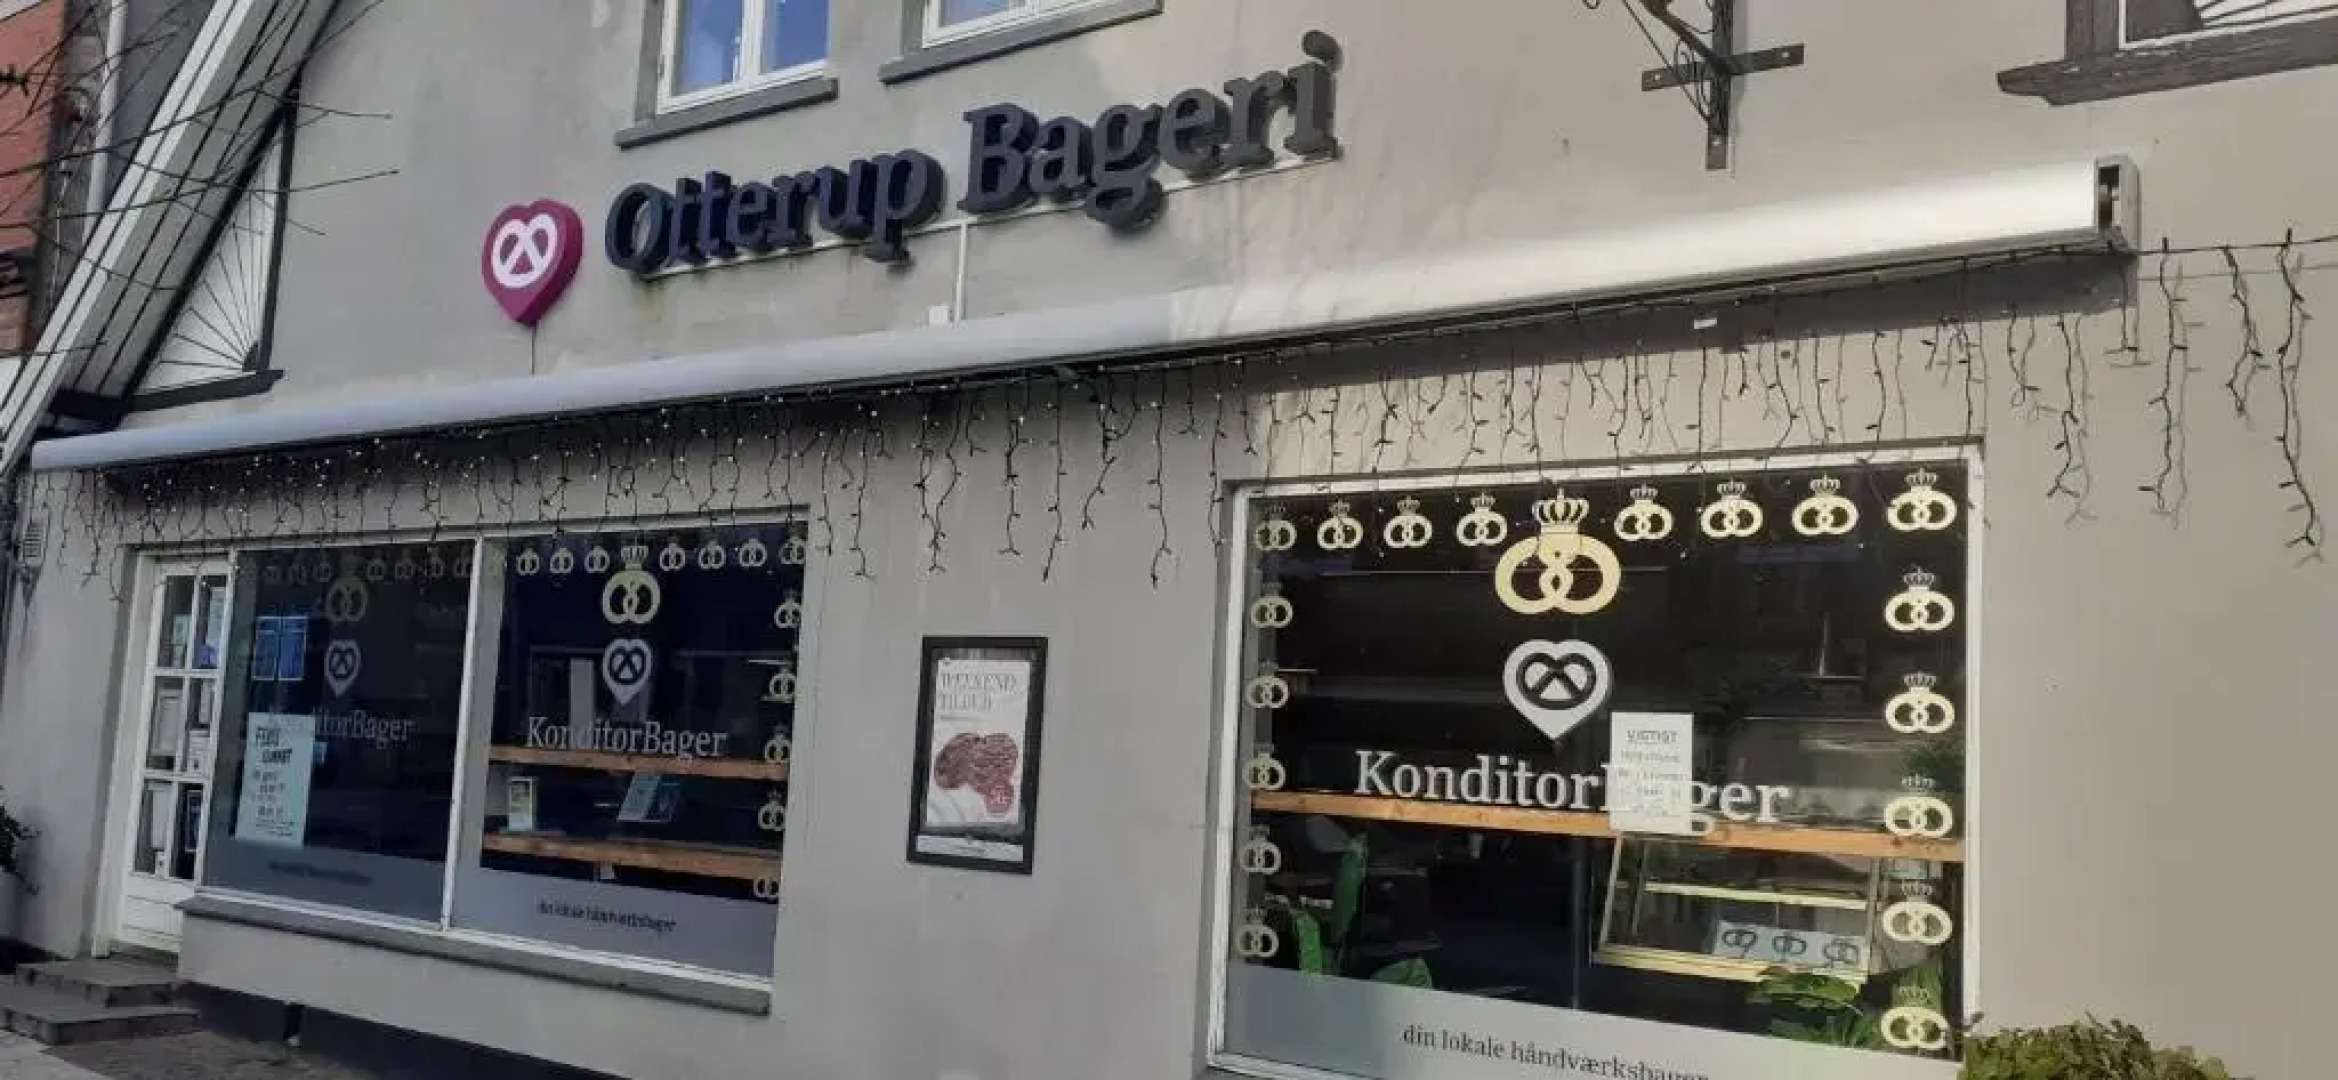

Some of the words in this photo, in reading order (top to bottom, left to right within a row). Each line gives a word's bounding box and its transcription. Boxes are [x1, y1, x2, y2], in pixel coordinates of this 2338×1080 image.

[604, 148, 946, 273] Otterup
[958, 30, 1343, 233] Bageri
[527, 715, 727, 764] KonditorBager
[1353, 749, 1789, 835] Konditorger
[1403, 1024, 1435, 1047] din
[1442, 1029, 1505, 1059] lokale
